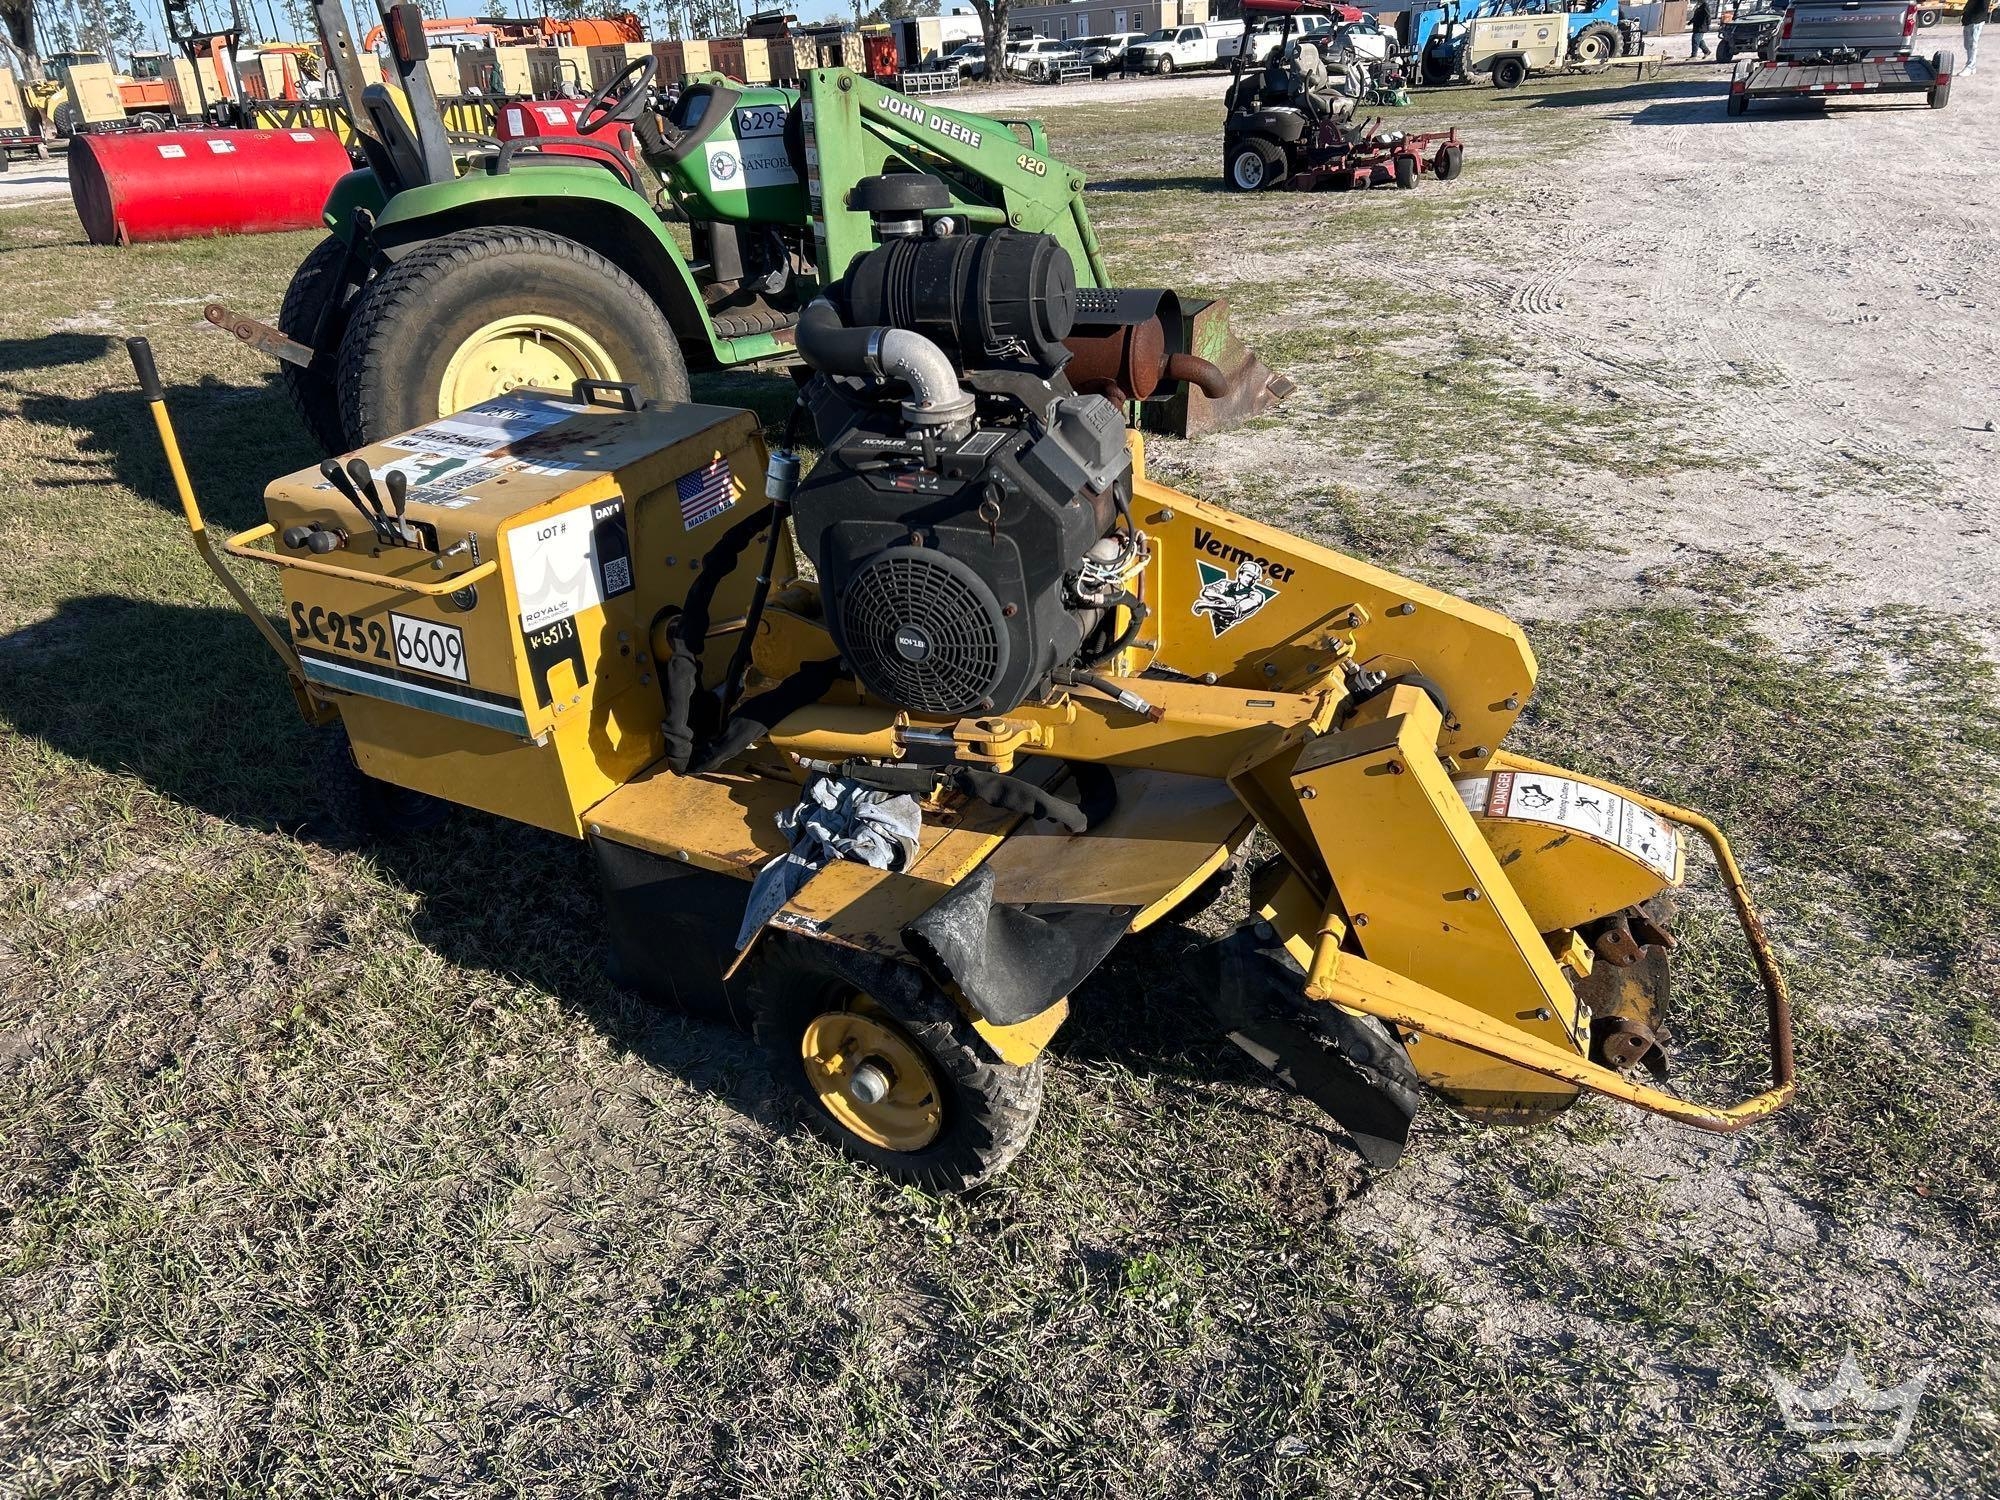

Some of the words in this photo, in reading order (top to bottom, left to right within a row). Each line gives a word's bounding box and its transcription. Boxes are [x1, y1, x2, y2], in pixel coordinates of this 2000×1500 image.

[740, 110, 788, 131] 6295
[878, 94, 926, 126] JOHN
[929, 113, 982, 149] DEERE
[738, 157, 793, 171] SANFOR
[1016, 153, 1048, 177] 420
[862, 438, 906, 446] KOHLER
[595, 505, 614, 520] DAY
[614, 503, 620, 513] 1
[687, 512, 709, 529] MADE
[709, 507, 718, 517] IN
[718, 500, 733, 512] USA
[537, 525, 558, 541] LOT
[560, 523, 567, 534] #
[1194, 526, 1296, 583] Vermeer
[526, 605, 560, 622] ROYAL
[291, 601, 392, 660] SC252
[398, 622, 462, 673] 6609
[1493, 772, 1512, 805] DANGER
